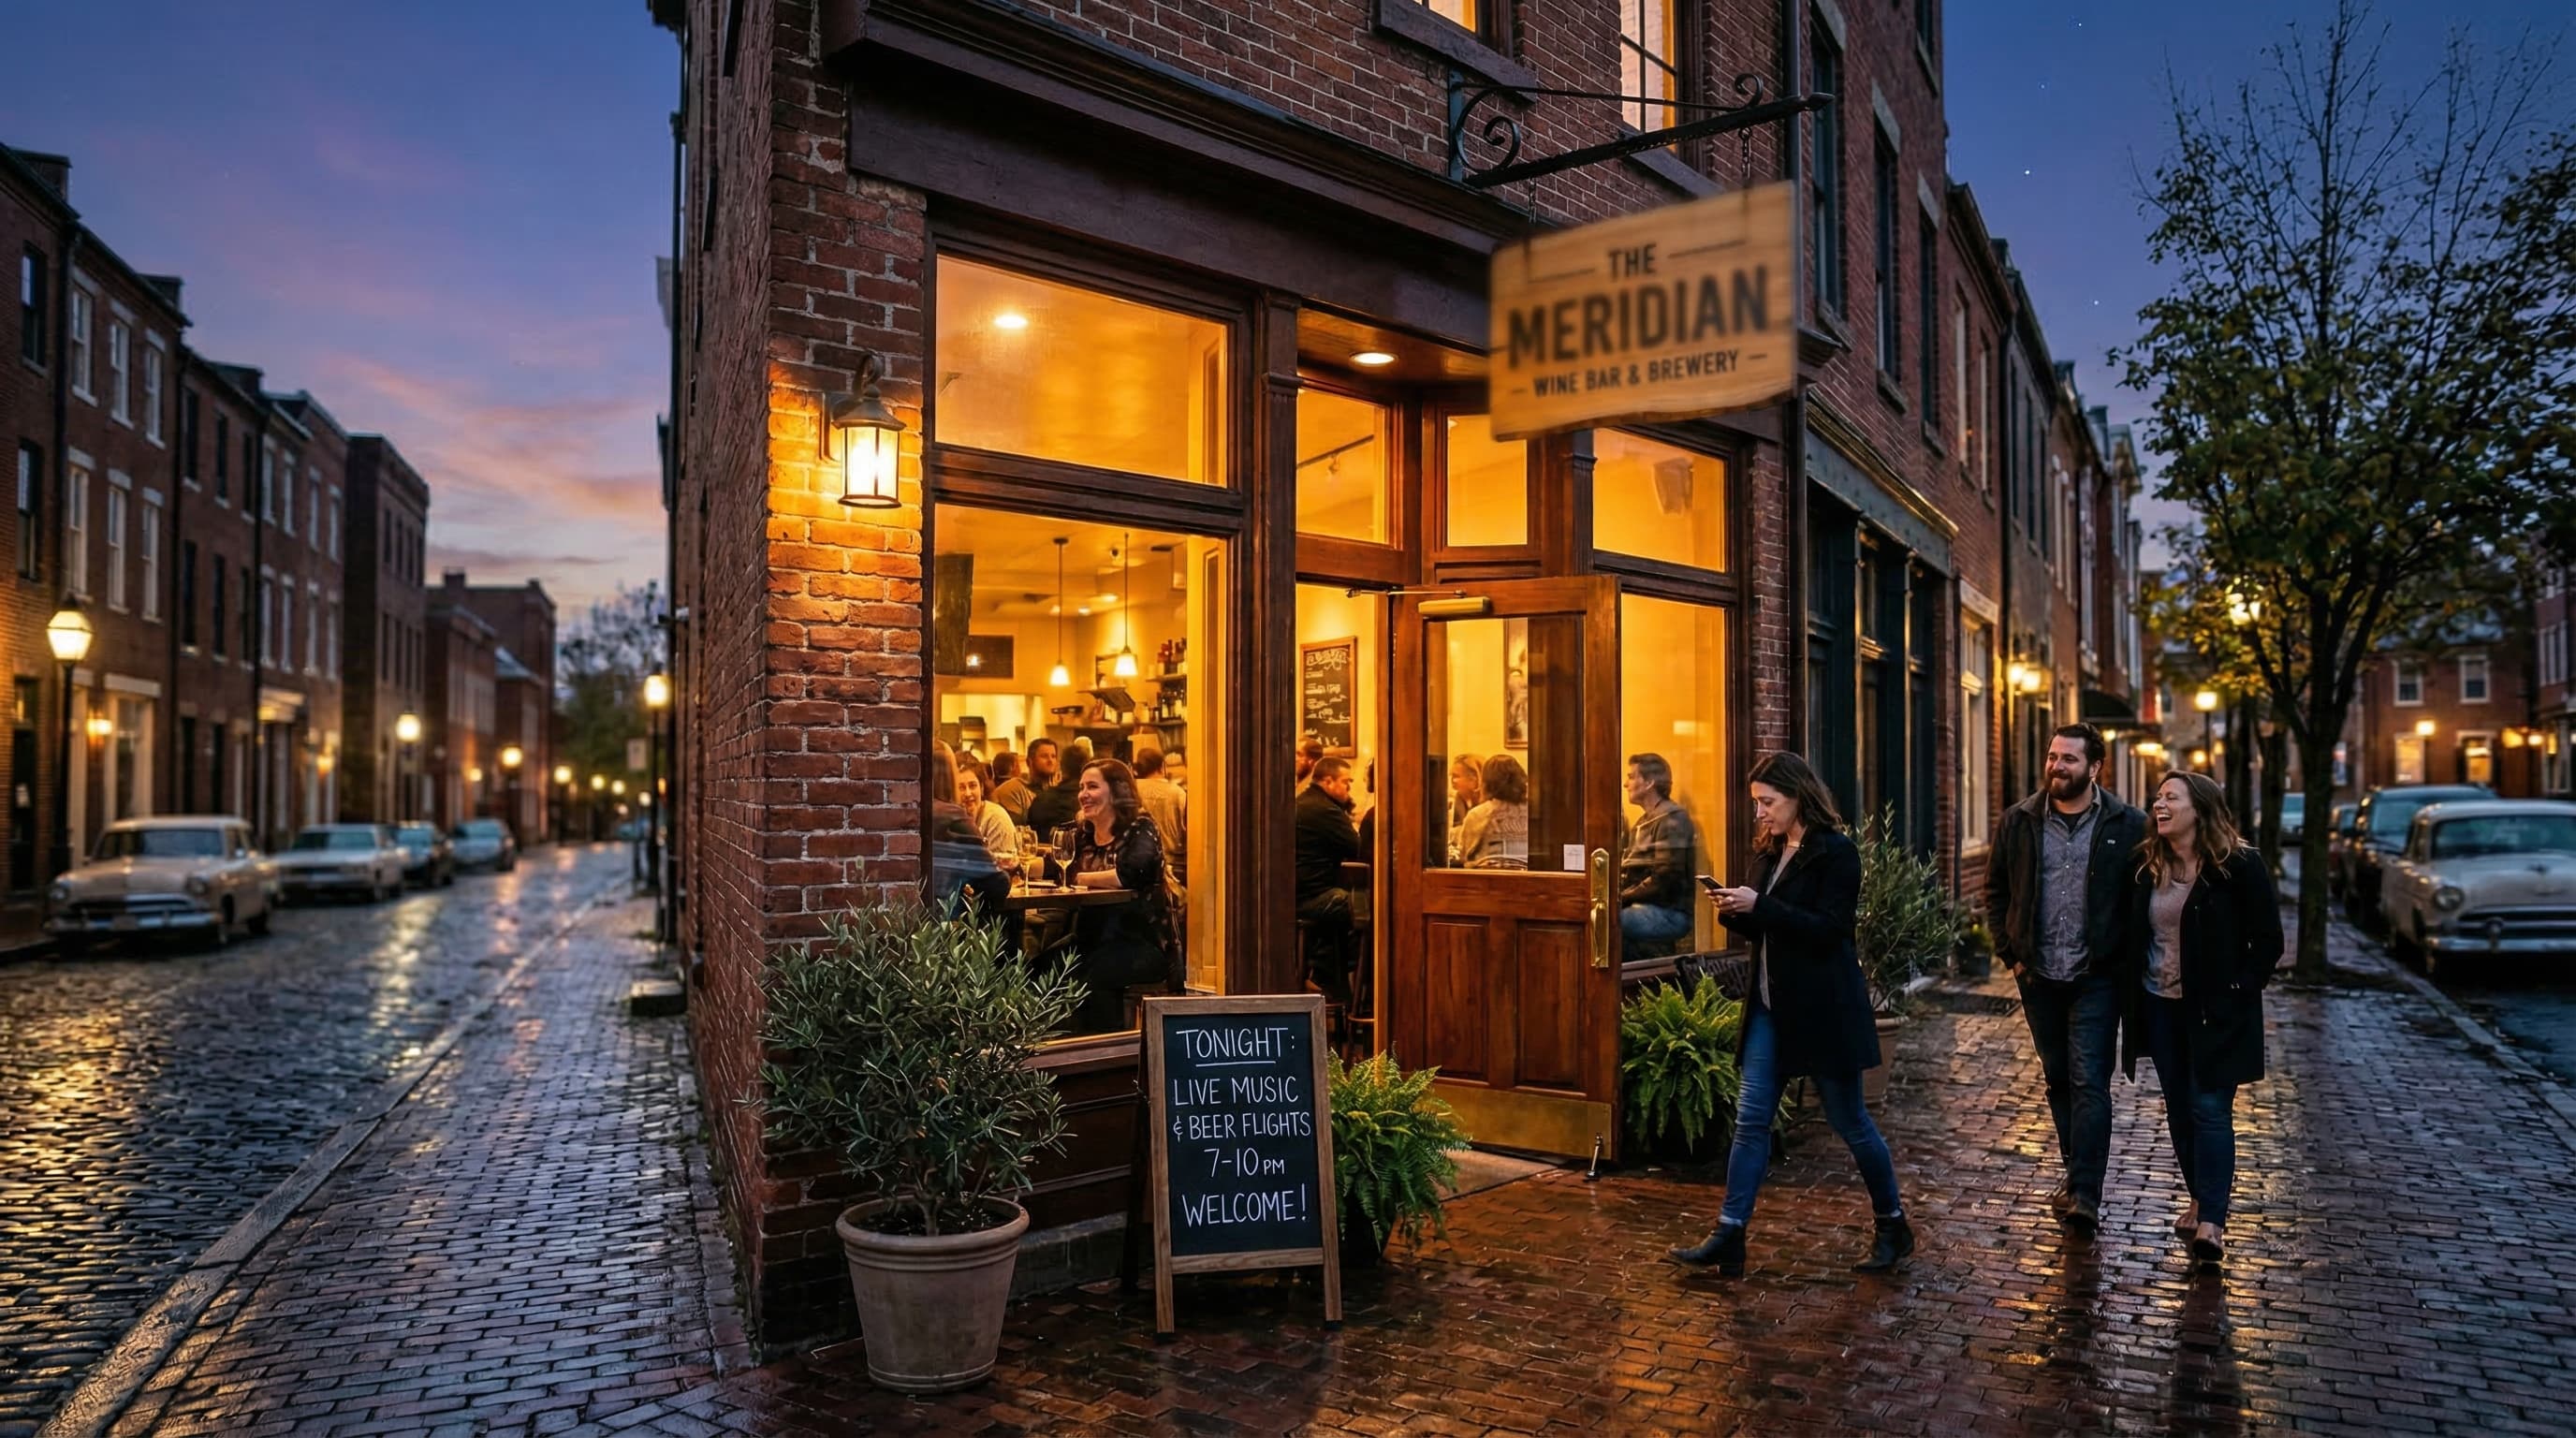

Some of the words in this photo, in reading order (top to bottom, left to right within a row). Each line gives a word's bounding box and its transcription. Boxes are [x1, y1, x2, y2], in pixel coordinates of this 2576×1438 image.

[1607, 243, 1657, 278] THE
[1507, 265, 1770, 369] MERIDIAN
[1532, 375, 1578, 397] WINE
[1586, 366, 1622, 391] BAR
[1629, 365, 1640, 385] &
[1647, 349, 1739, 381] BREWERY
[1176, 1027, 1295, 1059] TONIGHT:
[1174, 1078, 1222, 1106] LIVE
[1231, 1076, 1299, 1104] MUSIC
[1173, 1115, 1183, 1142] &
[1189, 1113, 1237, 1140] BEER
[1242, 1111, 1311, 1137] FLIGHTS
[1181, 1183, 1307, 1227] WELCOME!
